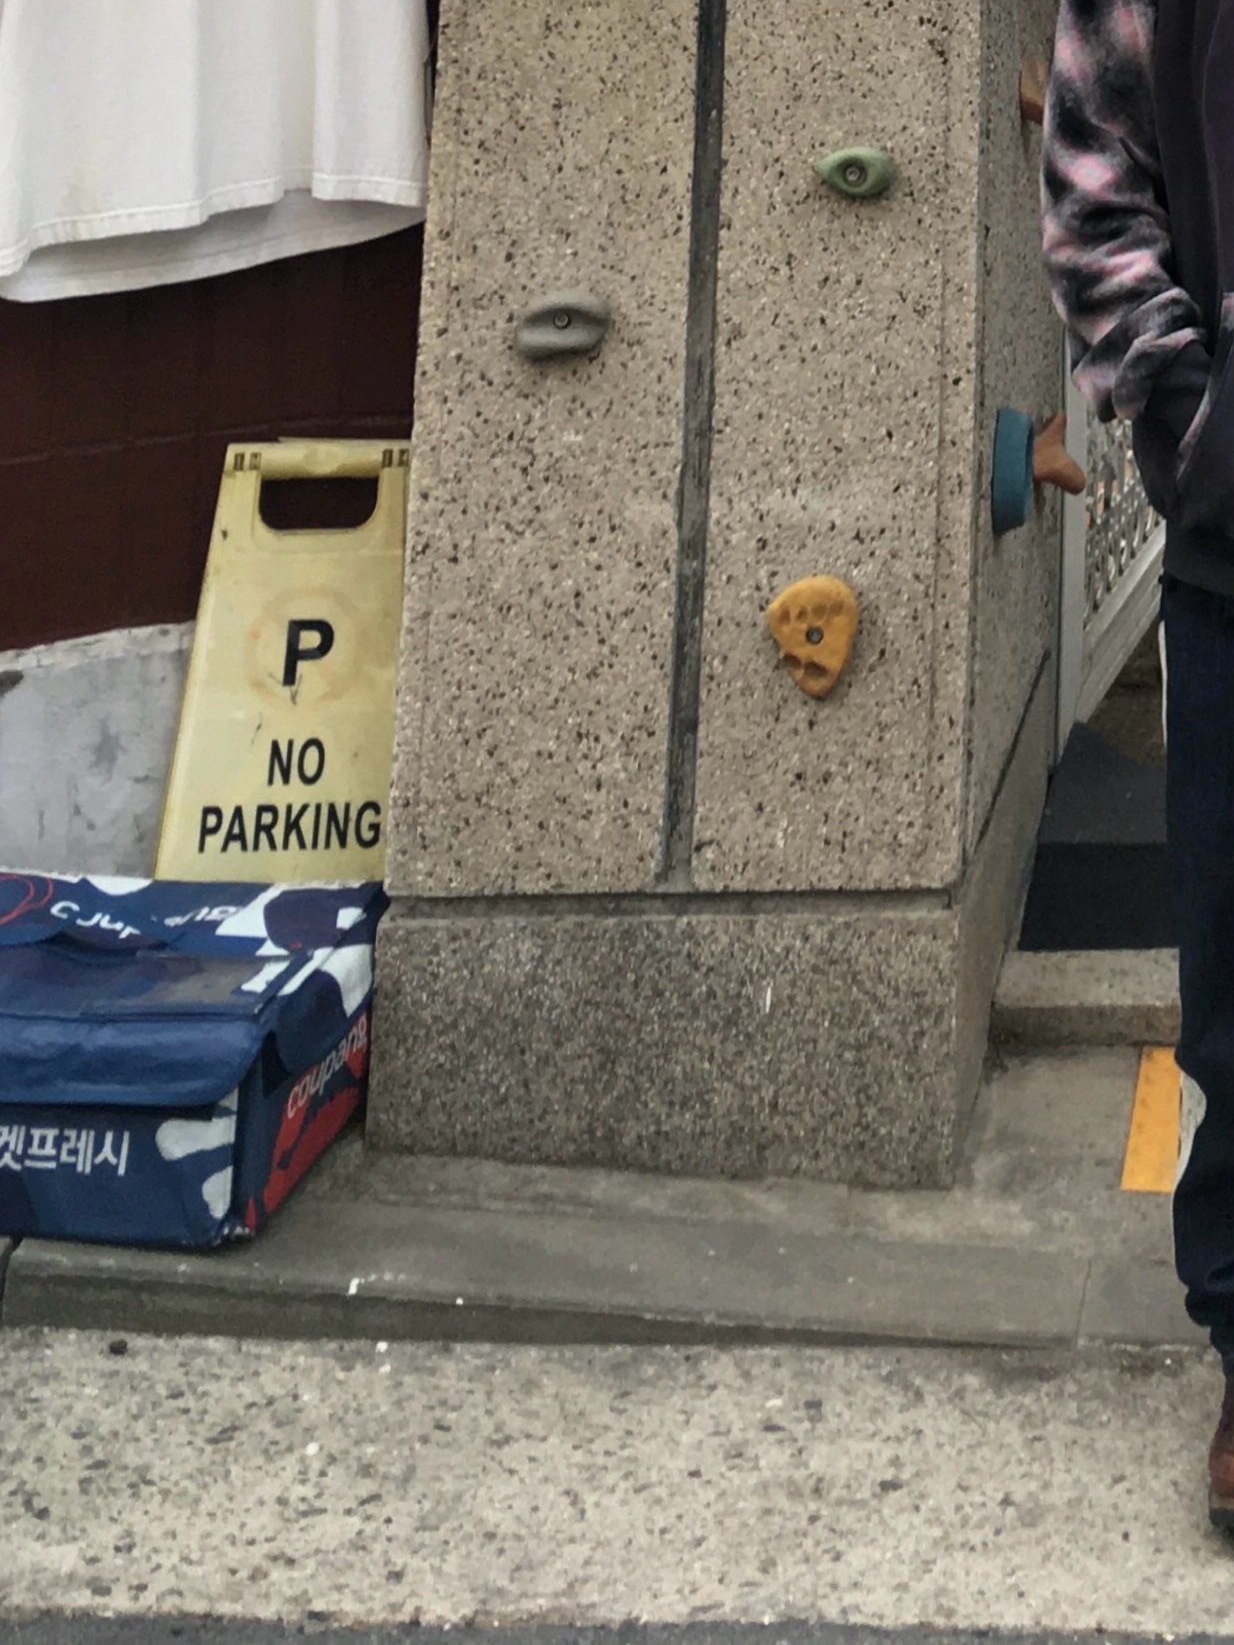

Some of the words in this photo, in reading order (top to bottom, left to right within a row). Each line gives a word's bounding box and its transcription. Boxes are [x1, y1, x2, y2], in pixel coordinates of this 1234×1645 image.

[282, 619, 334, 687] P
[267, 737, 326, 787] NO
[197, 800, 382, 854] PARKING
